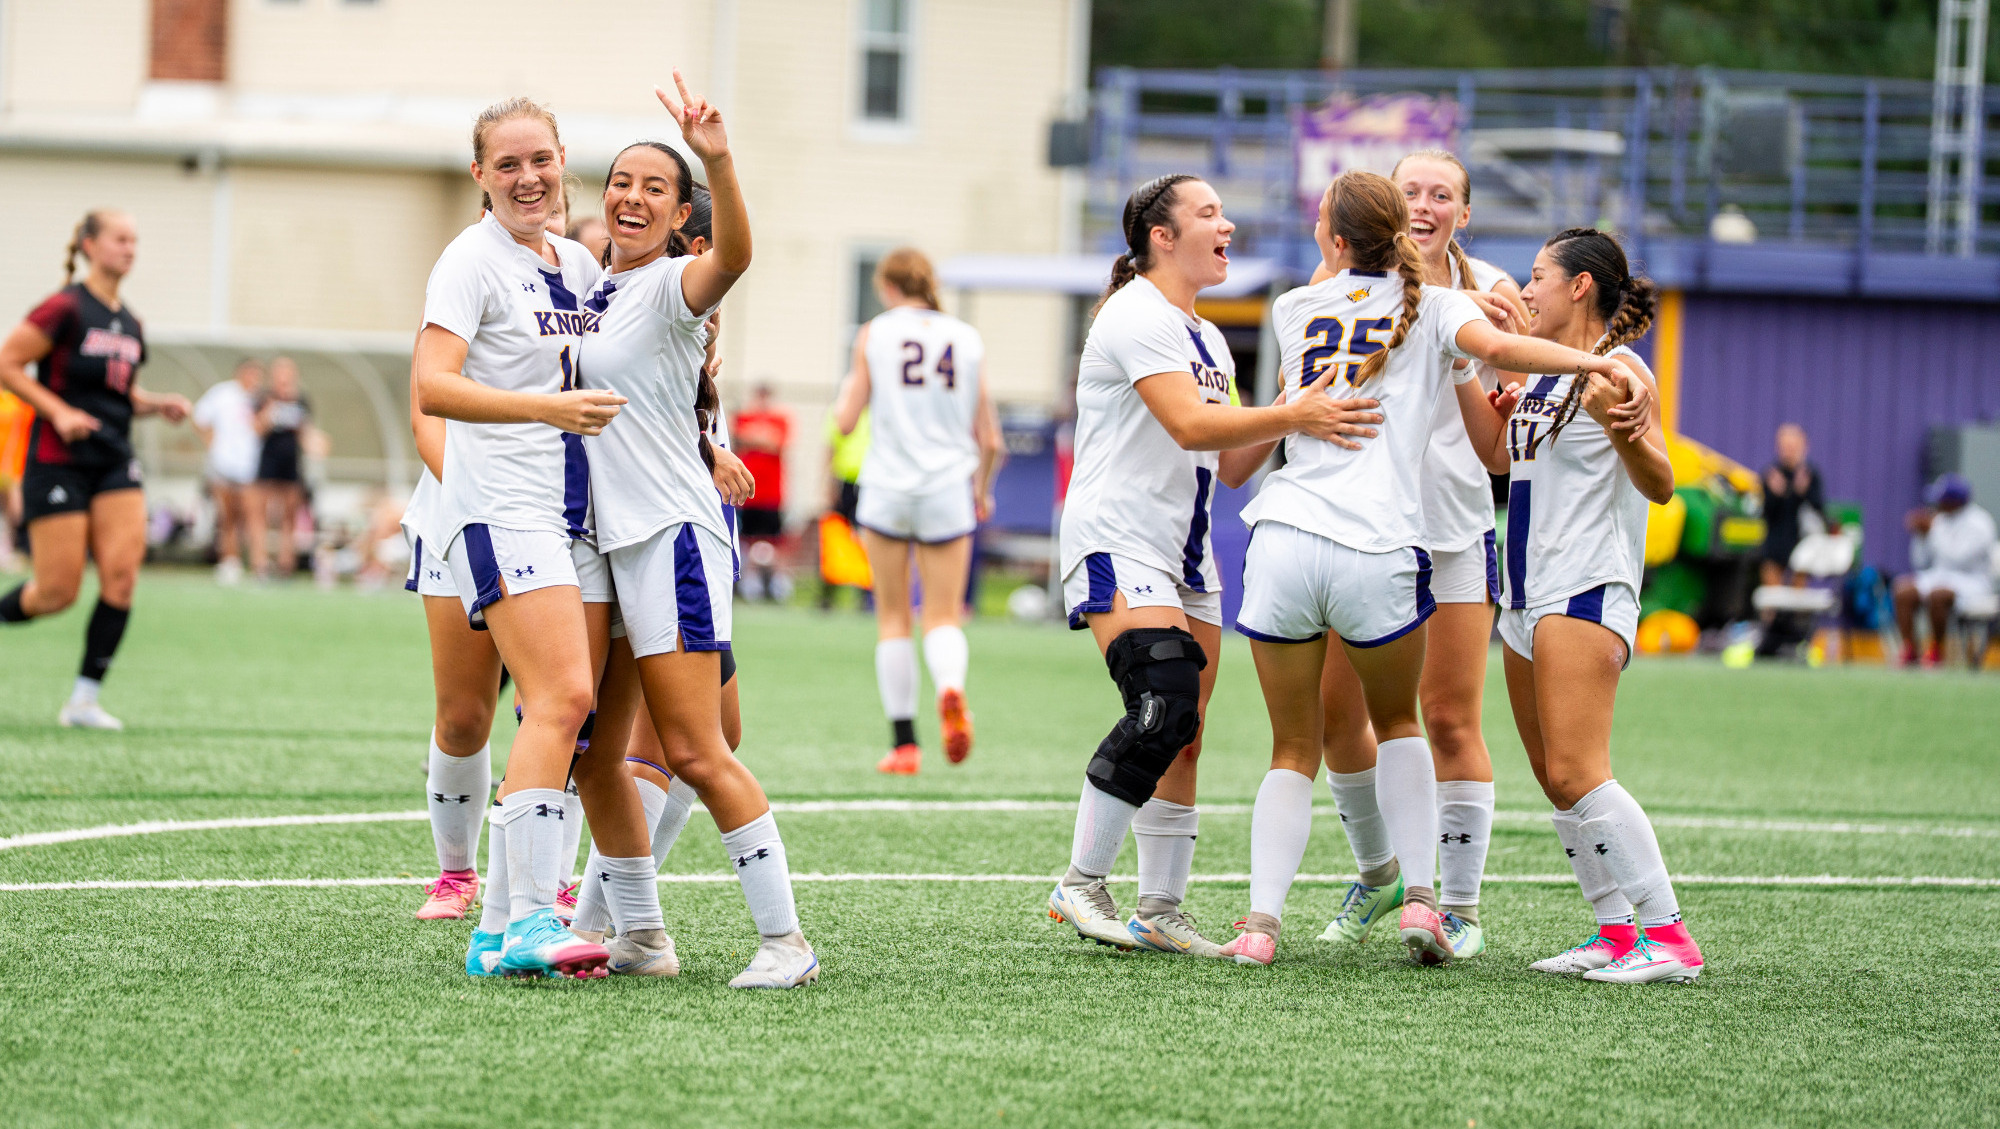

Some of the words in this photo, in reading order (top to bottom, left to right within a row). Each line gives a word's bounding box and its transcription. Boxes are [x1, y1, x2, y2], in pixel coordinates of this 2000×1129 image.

[533, 311, 584, 337] KNO
[559, 344, 578, 392] 1
[902, 341, 955, 389] 24
[1300, 316, 1394, 389] 25
[1513, 398, 1566, 421] NOX
[1510, 418, 1539, 462] 17
